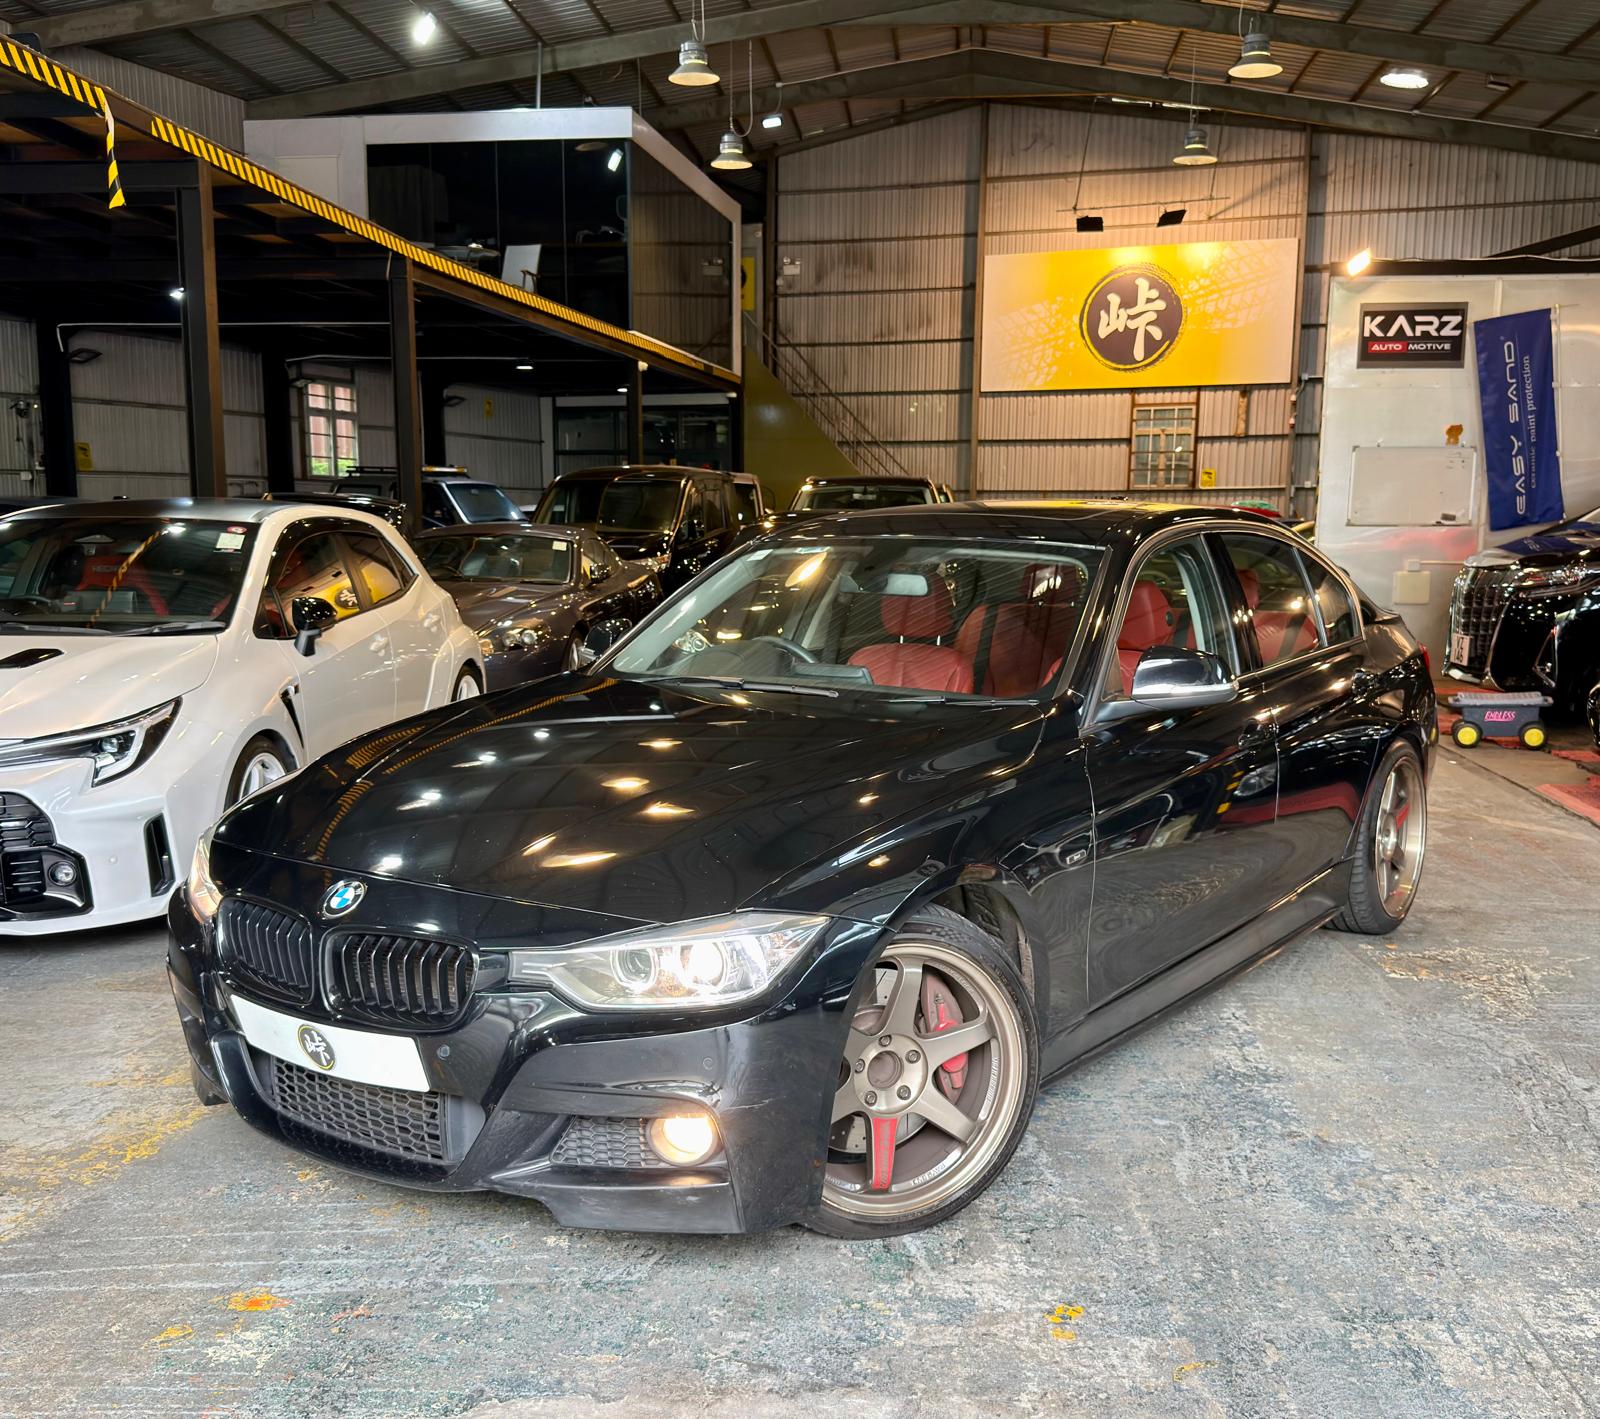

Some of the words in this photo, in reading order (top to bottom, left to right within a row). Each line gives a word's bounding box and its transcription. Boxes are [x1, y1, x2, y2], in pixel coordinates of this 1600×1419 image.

[1098, 278, 1166, 361] 峠
[1363, 314, 1463, 337] KARZ
[1371, 343, 1402, 351] AUTO
[1522, 355, 1537, 411] protection
[1527, 414, 1537, 442] paint
[1510, 435, 1526, 515] EASY
[1484, 710, 1516, 721] ENDLESS
